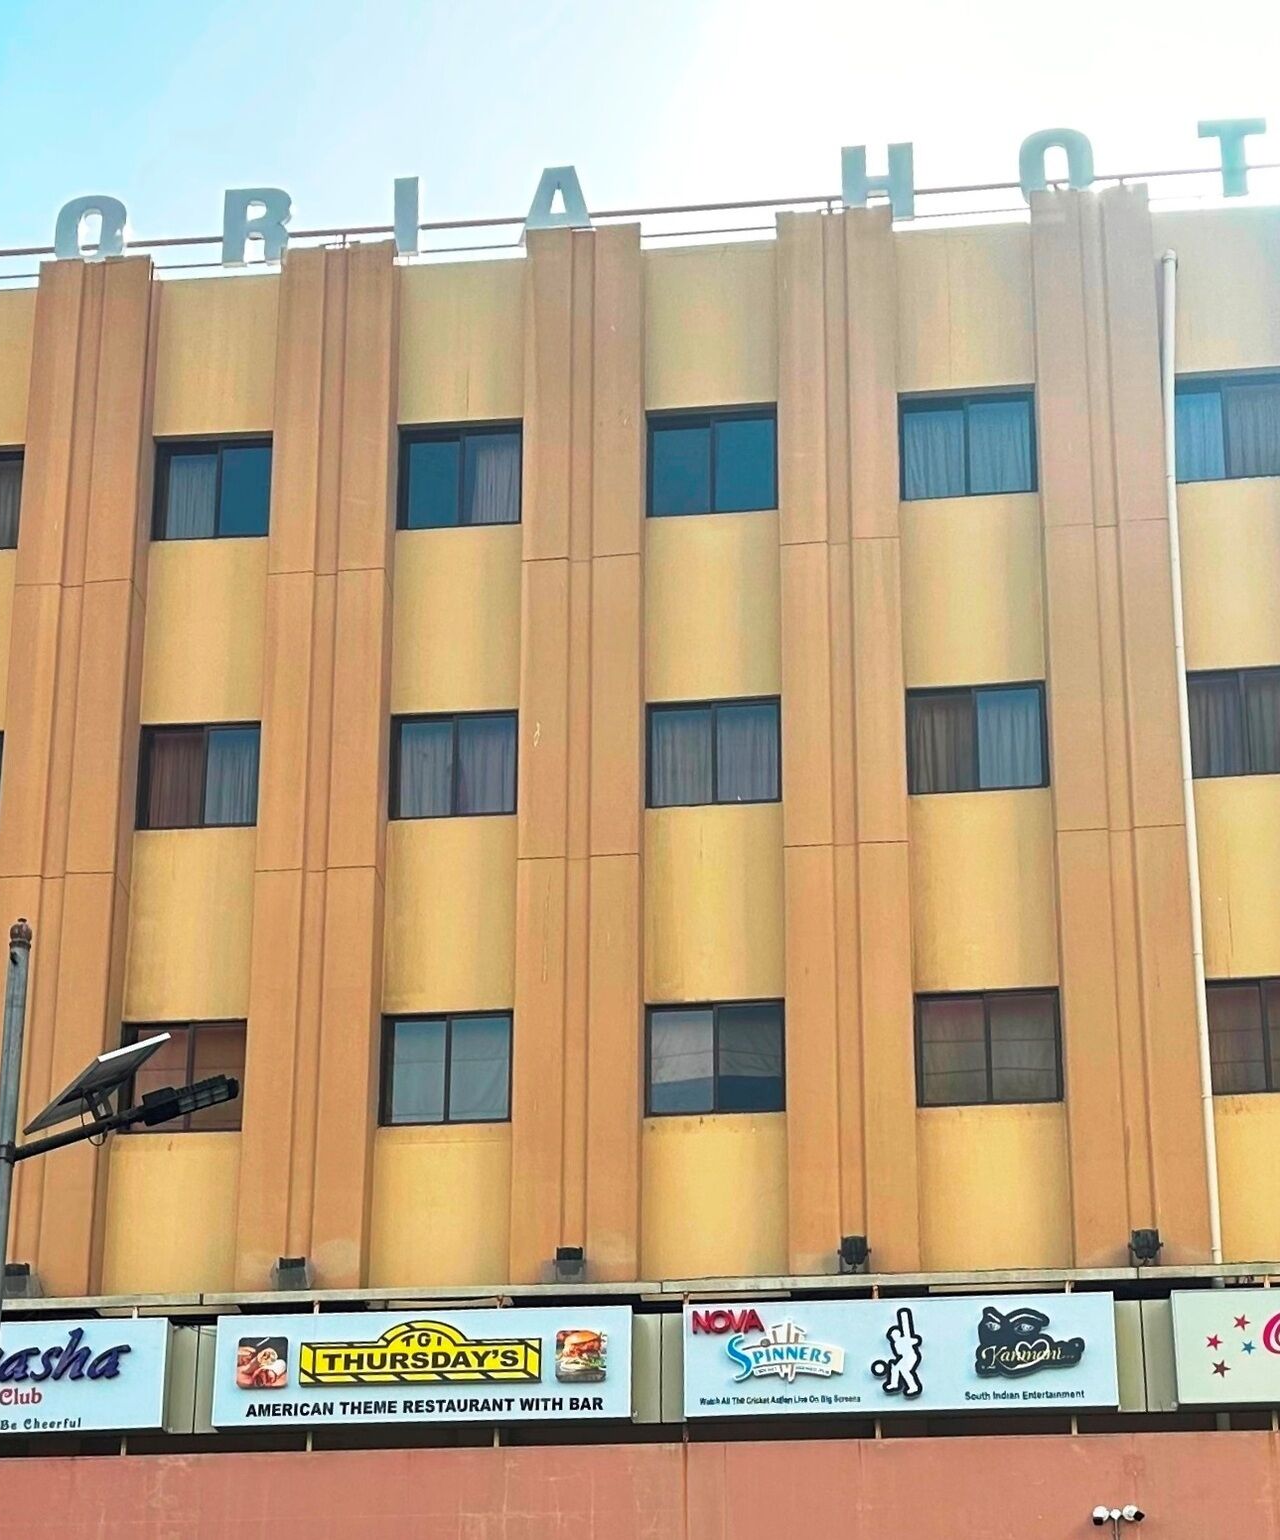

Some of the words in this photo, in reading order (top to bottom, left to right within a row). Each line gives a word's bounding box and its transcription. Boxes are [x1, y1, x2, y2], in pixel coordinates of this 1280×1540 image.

[692, 1309, 764, 1335] NOVA
[401, 1332, 442, 1347] TGI
[322, 1349, 519, 1371] THURSDAY'S
[727, 1333, 833, 1381] SPINNERS
[965, 1391, 990, 1400] South
[993, 1391, 1020, 1400] Indian
[1022, 1390, 1085, 1400] Entertainment
[245, 1402, 334, 1418] AMERICAN
[339, 1400, 398, 1416] THEME
[403, 1399, 514, 1414] RESTAURANT
[520, 1397, 563, 1412] WITH
[569, 1397, 604, 1411] BAR
[0, 1420, 17, 1431] Be
[23, 1417, 81, 1430] Cheerful
